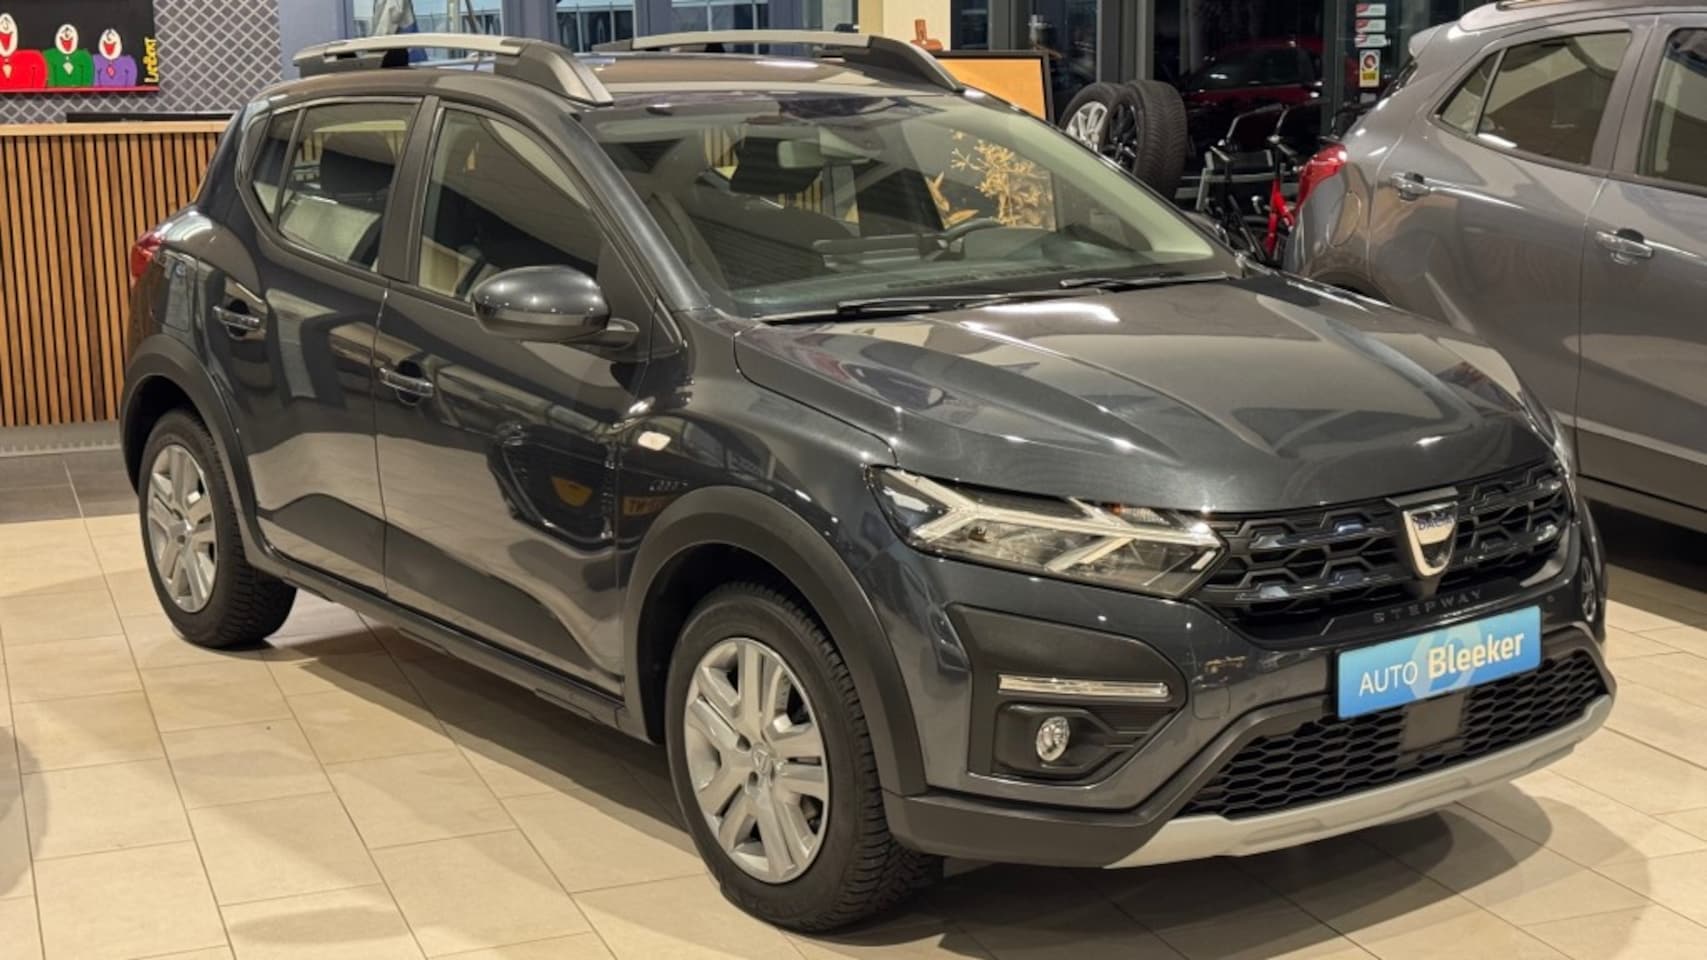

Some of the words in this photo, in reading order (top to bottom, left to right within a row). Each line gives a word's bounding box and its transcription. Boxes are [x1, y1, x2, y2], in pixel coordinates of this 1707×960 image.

[1373, 590, 1481, 624] STEPWAY
[1359, 661, 1418, 697] AUTO
[1428, 633, 1525, 680] Bleeker
